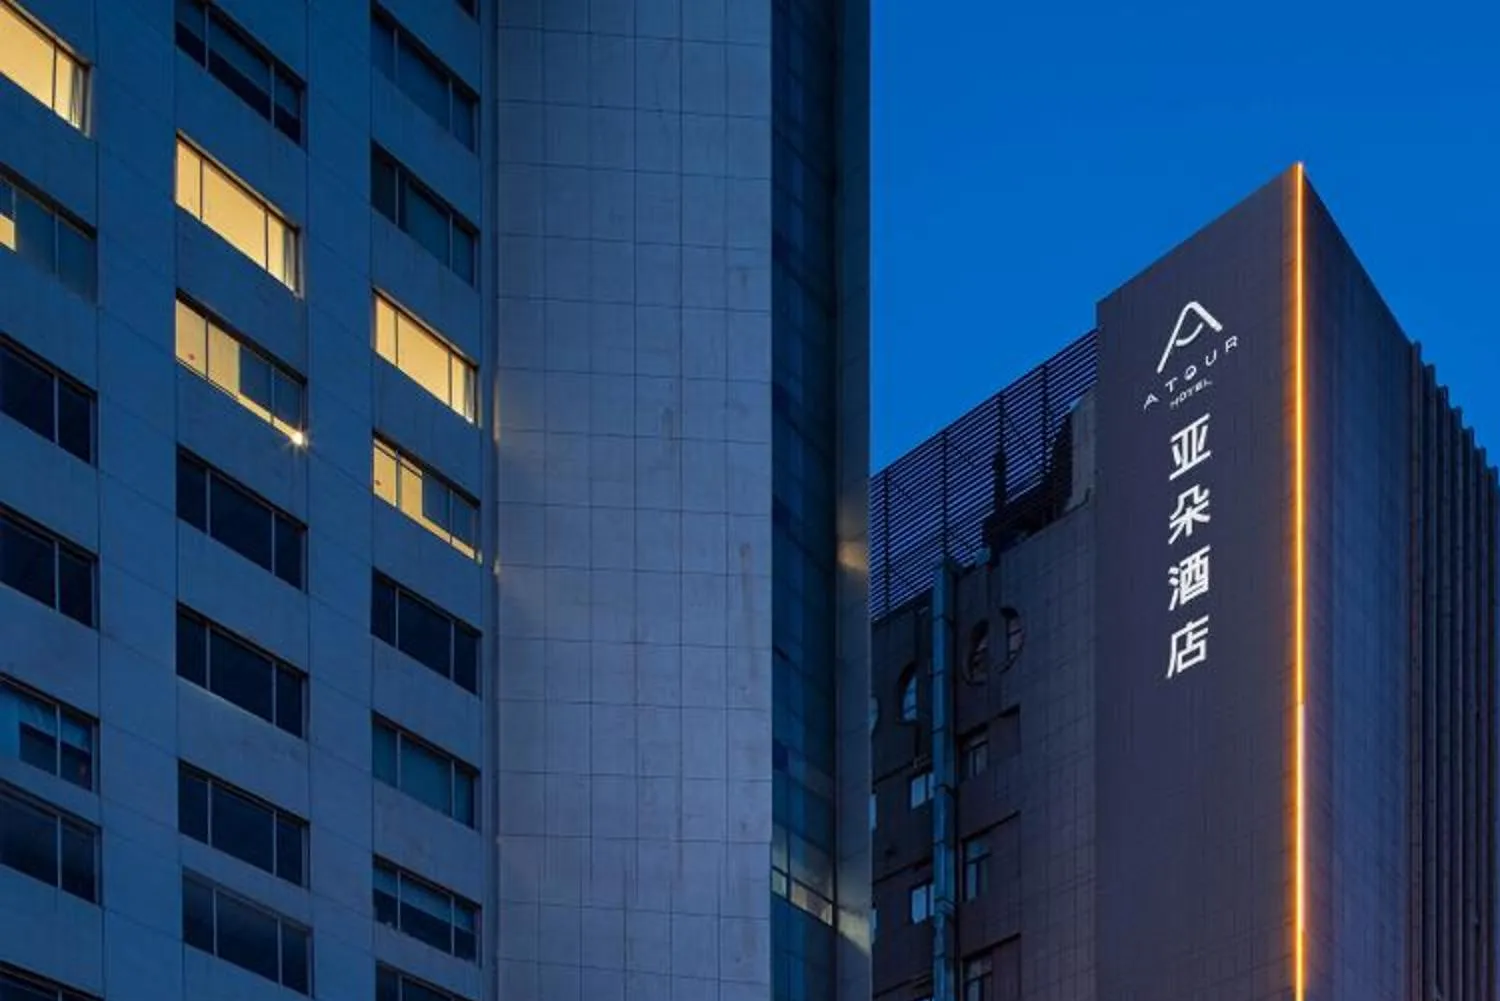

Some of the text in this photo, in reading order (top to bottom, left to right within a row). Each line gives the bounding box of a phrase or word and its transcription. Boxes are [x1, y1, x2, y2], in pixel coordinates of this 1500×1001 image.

[1144, 335, 1238, 410] ATOUR
[1166, 413, 1212, 680] 亚朵酒店
